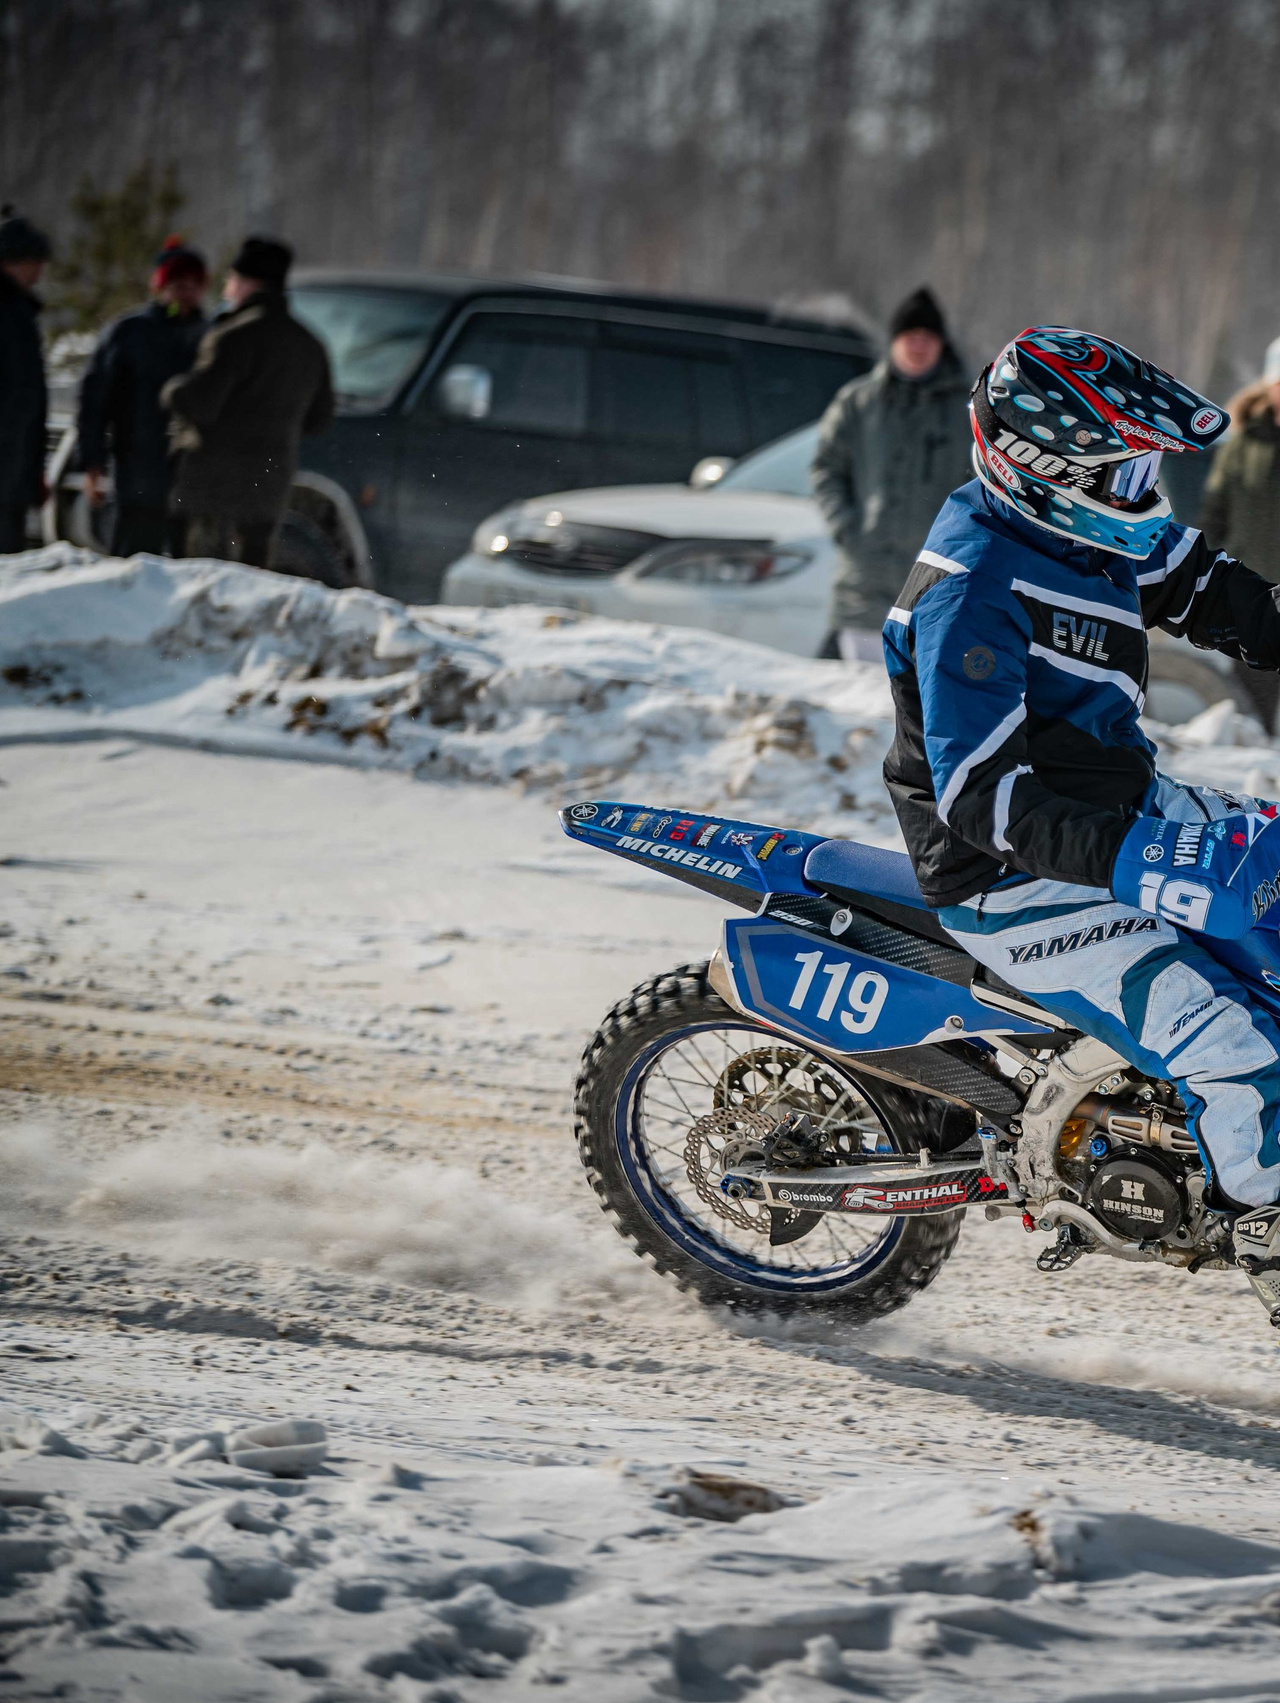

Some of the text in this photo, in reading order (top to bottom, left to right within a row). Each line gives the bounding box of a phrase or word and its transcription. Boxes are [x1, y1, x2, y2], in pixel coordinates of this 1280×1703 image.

[1195, 411, 1217, 430] BELL
[990, 453, 1014, 486] BELL
[994, 428, 1102, 488] 100%
[1053, 611, 1110, 661] EVIL
[616, 835, 743, 879] MICHELIN
[1005, 917, 1160, 965] YAMAHA
[788, 950, 889, 1034] 119
[792, 1191, 833, 1203] brembo
[1103, 1199, 1164, 1218] HINSON
[1121, 1179, 1145, 1202] H
